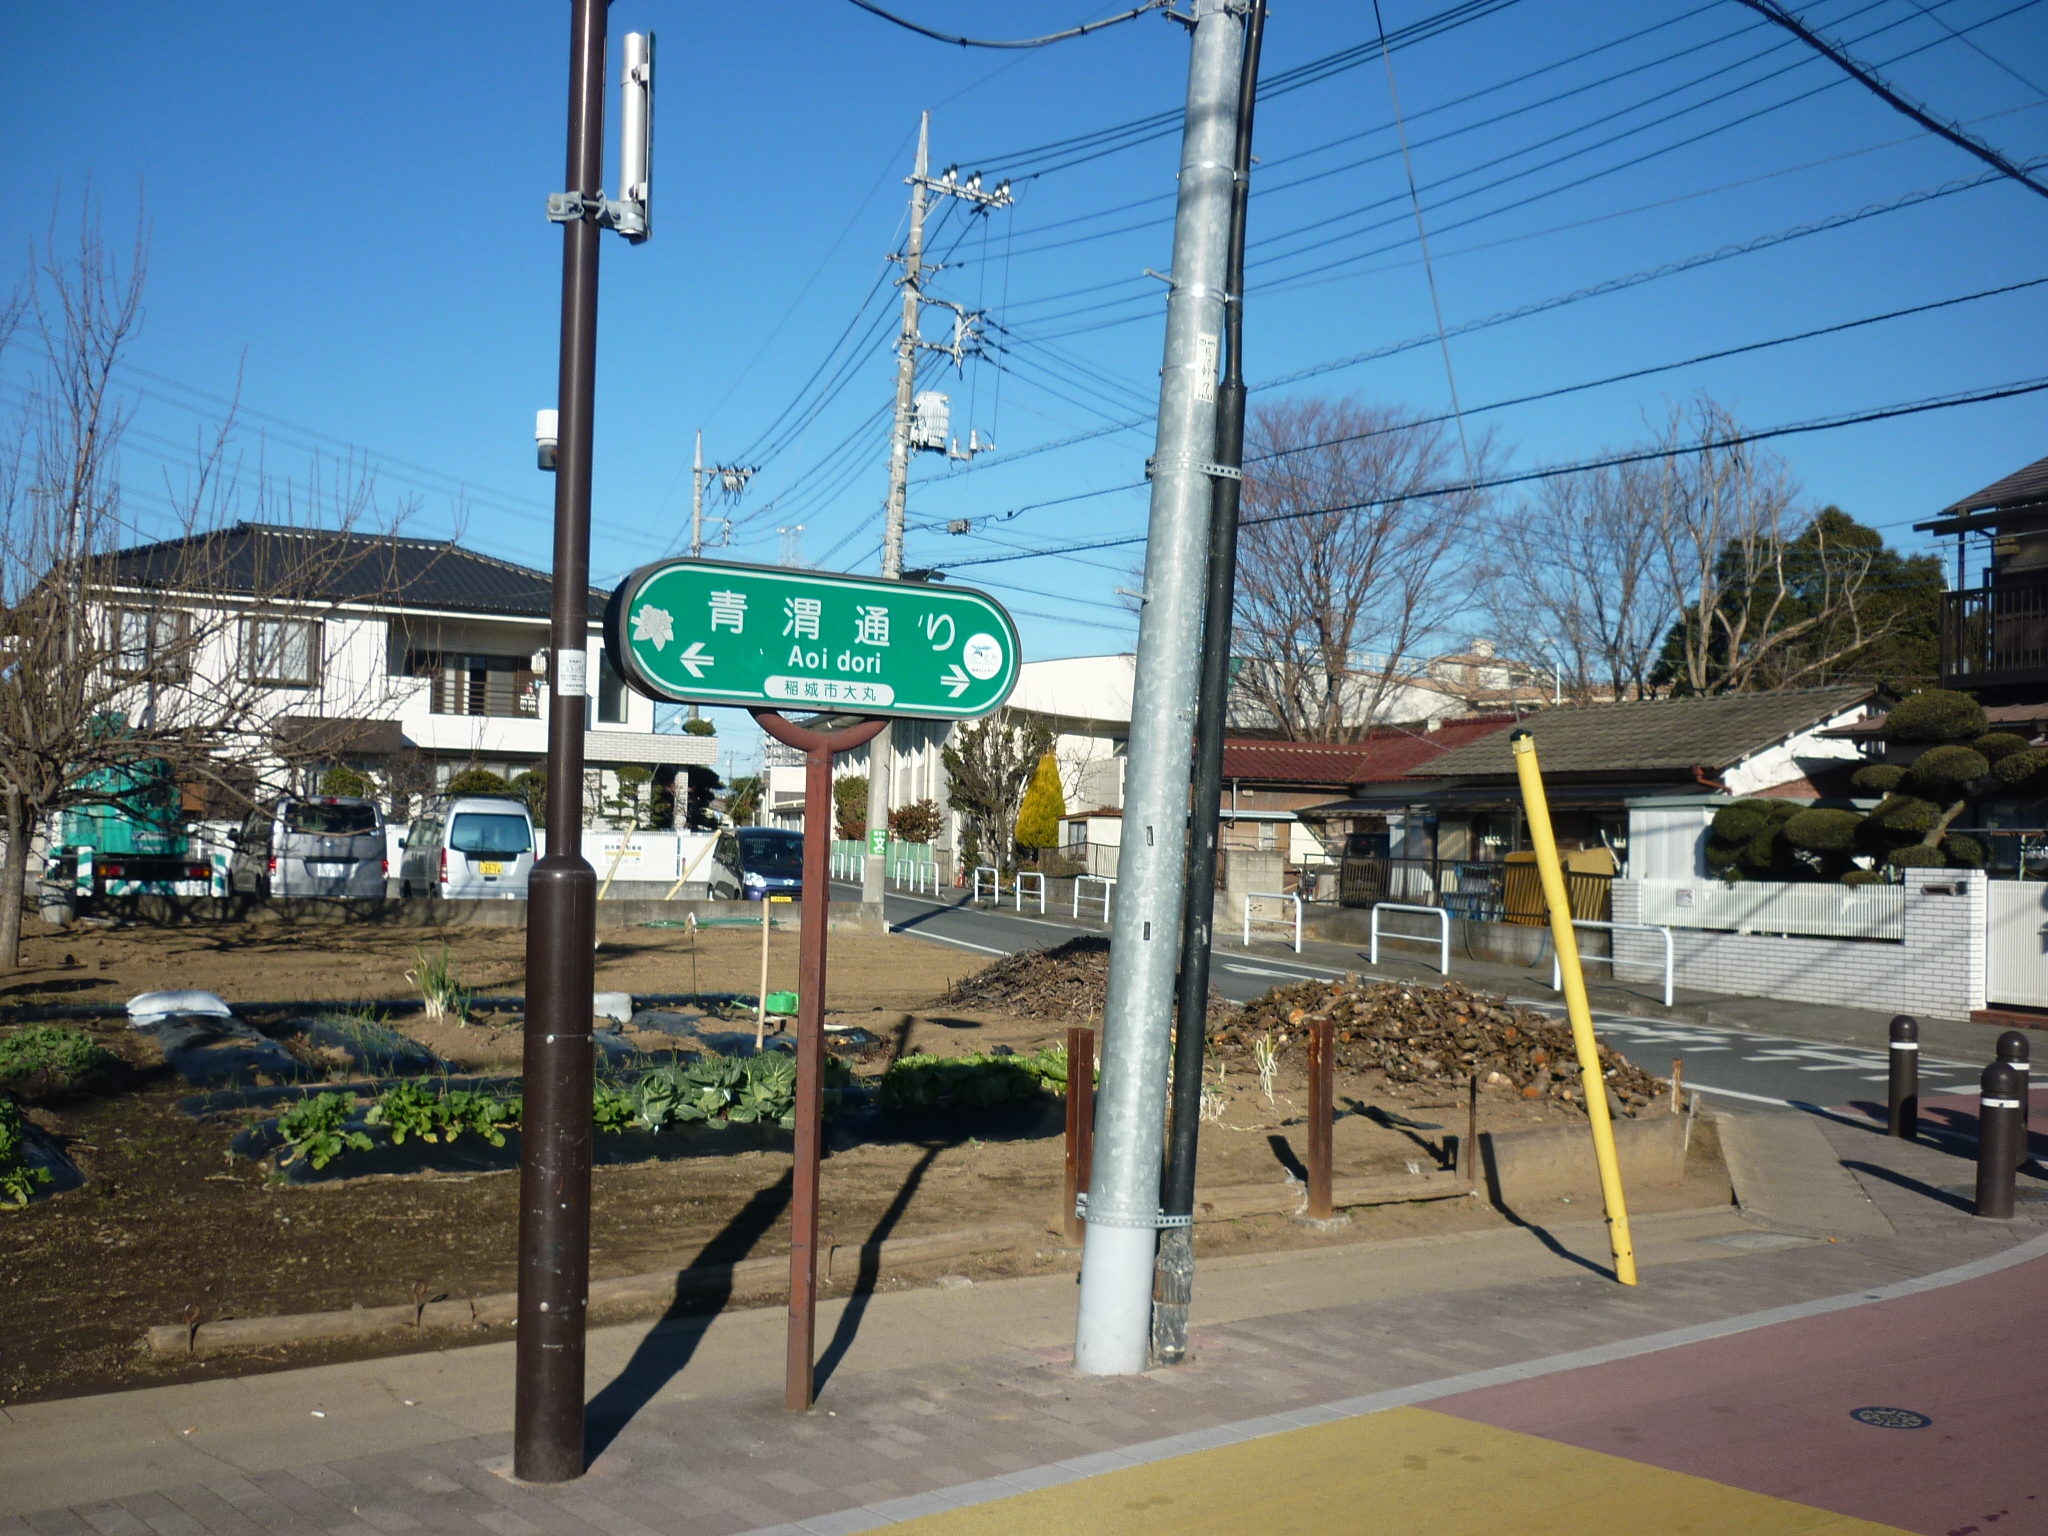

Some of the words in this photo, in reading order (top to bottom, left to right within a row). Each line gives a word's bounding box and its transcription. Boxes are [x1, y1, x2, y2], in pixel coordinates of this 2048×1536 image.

[708, 590, 956, 652] 青渭通り
[787, 645, 828, 670] Aoi
[837, 650, 881, 674] dori
[784, 680, 877, 702] 稲城市大丸
